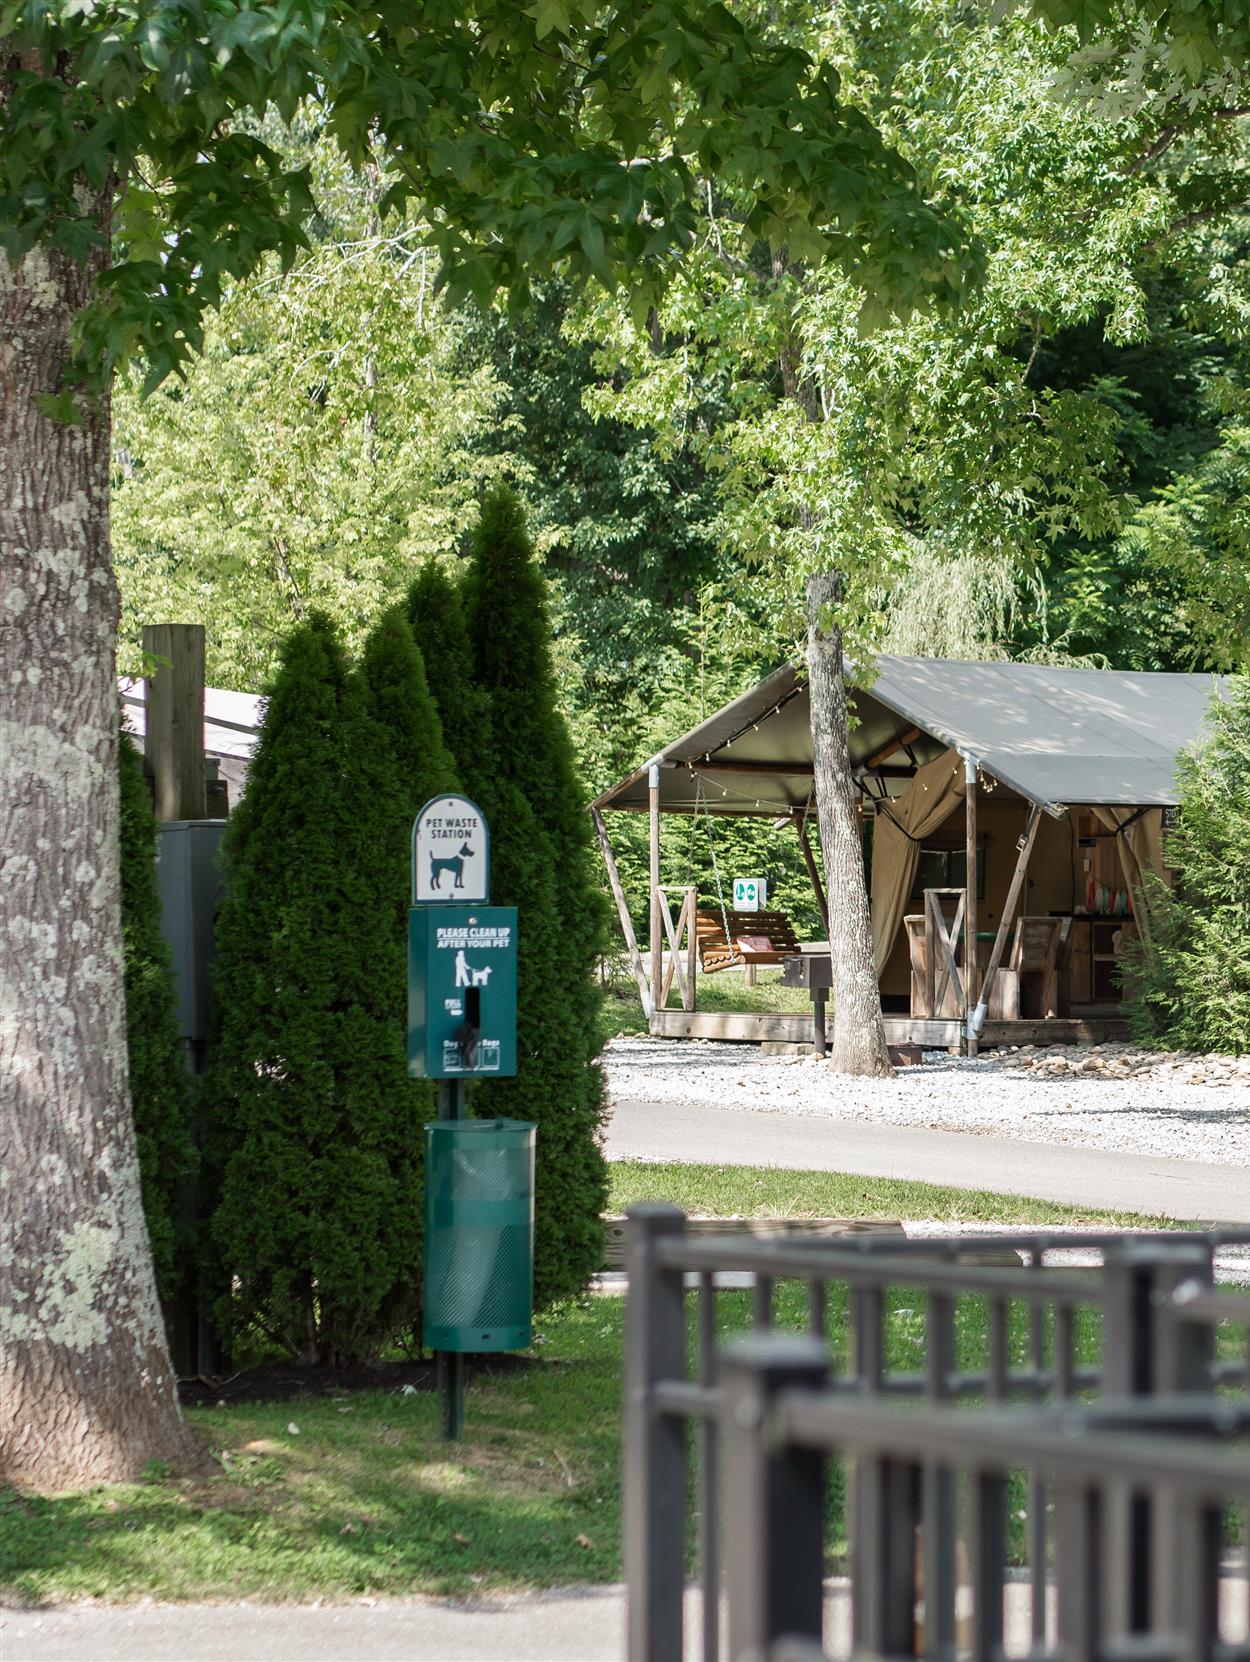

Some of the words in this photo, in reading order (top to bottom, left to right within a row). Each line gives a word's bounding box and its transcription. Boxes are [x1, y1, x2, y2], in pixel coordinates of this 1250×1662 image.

[426, 818, 442, 828] PET
[445, 818, 478, 828] WASTE
[431, 829, 472, 839] STATION
[436, 927, 469, 938] PLEASE
[469, 927, 497, 937] CLEAN
[497, 927, 511, 937] UP
[437, 939, 466, 948] AFTER
[466, 939, 492, 948] YOUR
[492, 939, 510, 948] PET
